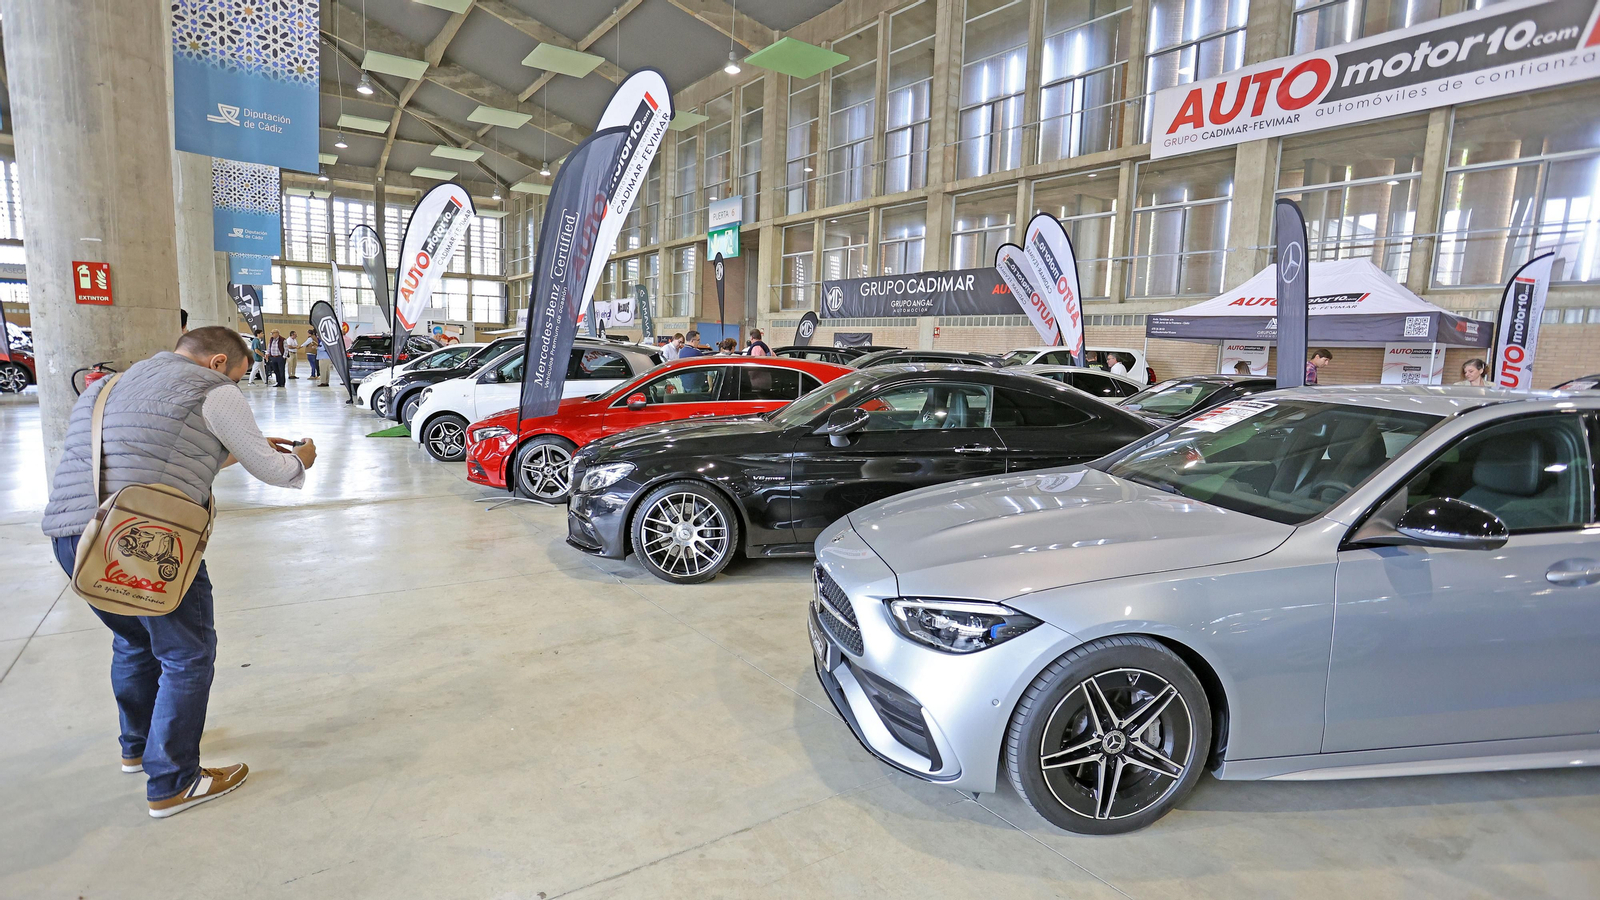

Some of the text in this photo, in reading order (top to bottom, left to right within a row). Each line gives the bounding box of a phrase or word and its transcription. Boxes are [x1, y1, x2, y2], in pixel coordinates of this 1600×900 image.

[1165, 19, 1579, 135] AUTO motor10.com
[1315, 50, 1597, 117] automóviles de confianza
[243, 107, 291, 125] Diputación
[243, 119, 283, 134] de Cádiz
[1163, 113, 1301, 148] GRUPO CADIMAR-FEVIMAR
[616, 112, 670, 215] CADIMAR-FEVIMAR
[712, 208, 736, 221] PUERTA 6
[244, 228, 268, 236] Diputación
[2, 267, 26, 275] ASEO
[400, 251, 431, 304] AUTO
[534, 213, 577, 387] Mercedes-Benz Certified
[828, 286, 844, 312] MG
[800, 320, 813, 337] MG
[1500, 345, 1525, 389] UTO
[99, 559, 167, 593] Vespa
